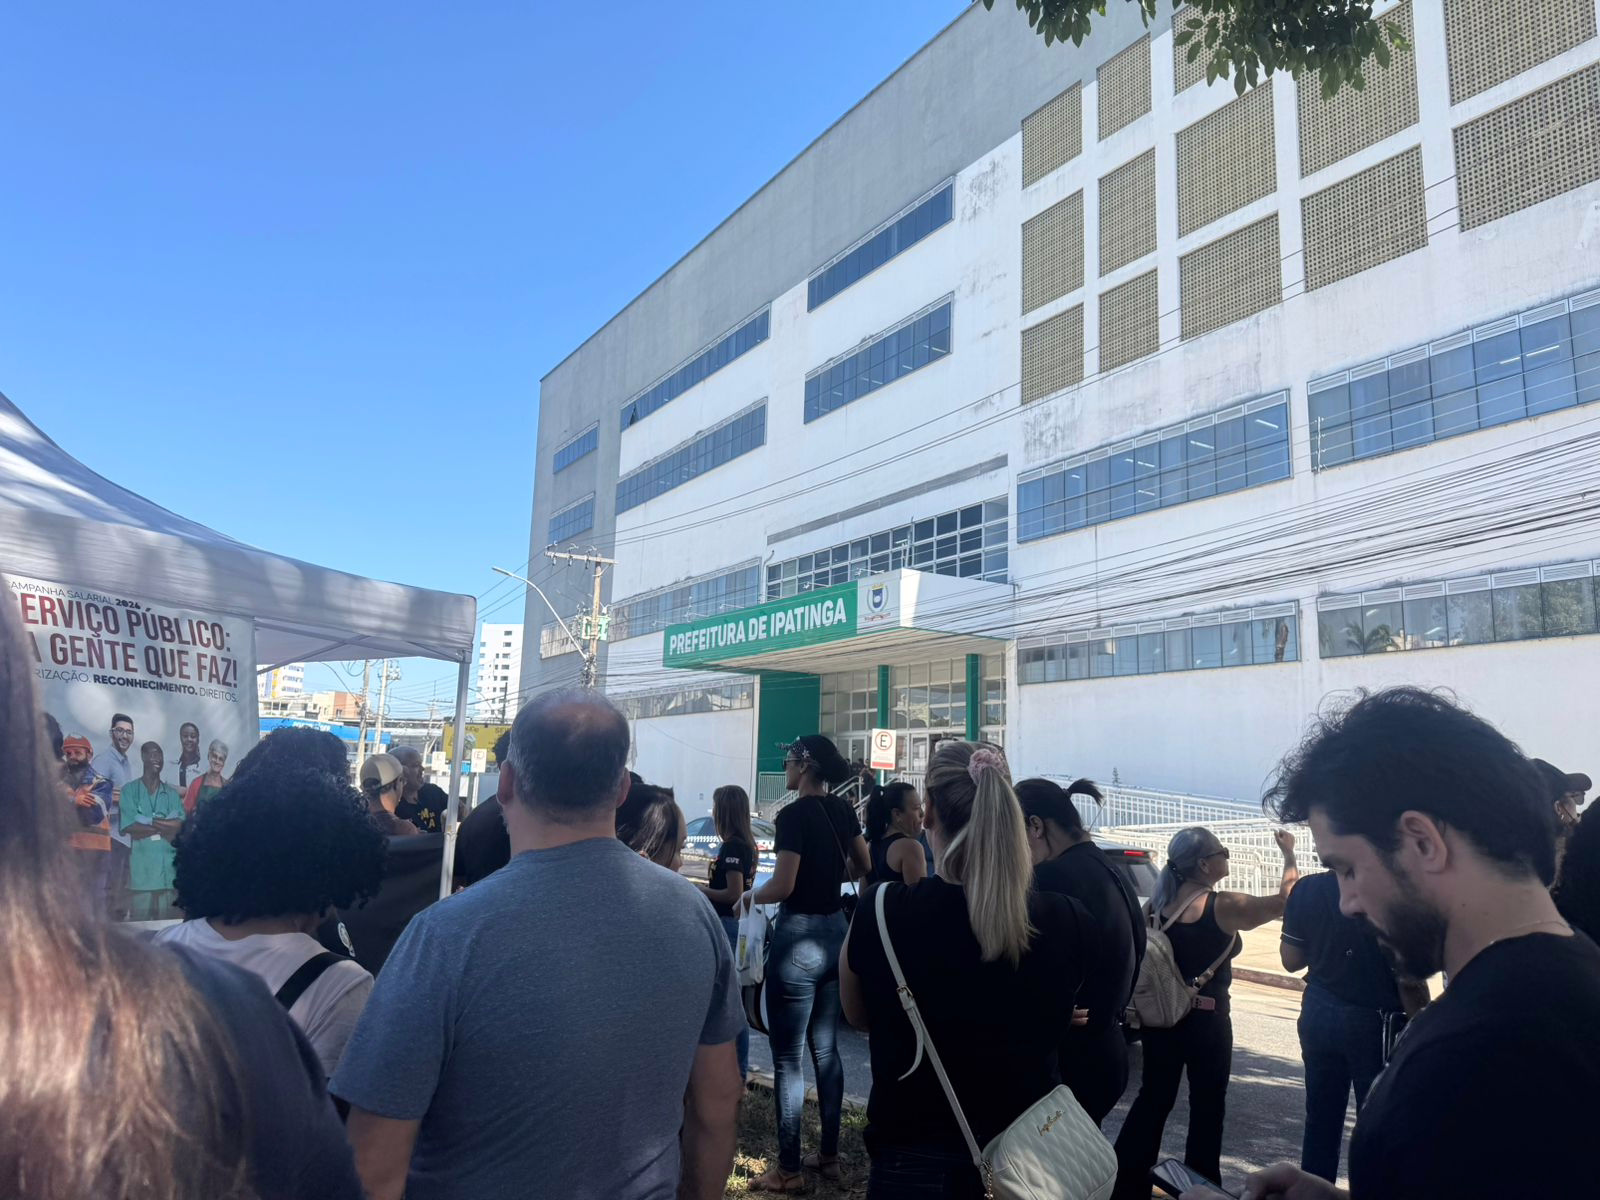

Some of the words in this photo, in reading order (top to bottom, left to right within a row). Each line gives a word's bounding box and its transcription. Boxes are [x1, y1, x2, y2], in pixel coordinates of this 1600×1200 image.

[67, 590, 114, 606] SALARIAL
[115, 598, 141, 609] 2026
[16, 592, 120, 638] ERVIÇO
[126, 607, 231, 652] PÚBLICO:
[669, 620, 746, 656] PREFEITURA
[748, 615, 768, 642] DE
[770, 597, 847, 638] IPATINGA
[50, 632, 138, 674] GENTE
[144, 645, 191, 680] QUE
[196, 652, 238, 689] FAZ!
[34, 668, 92, 684] RIZAÇÃO.
[93, 674, 198, 696] RECONHECIMENTO.
[880, 734, 888, 748] E
